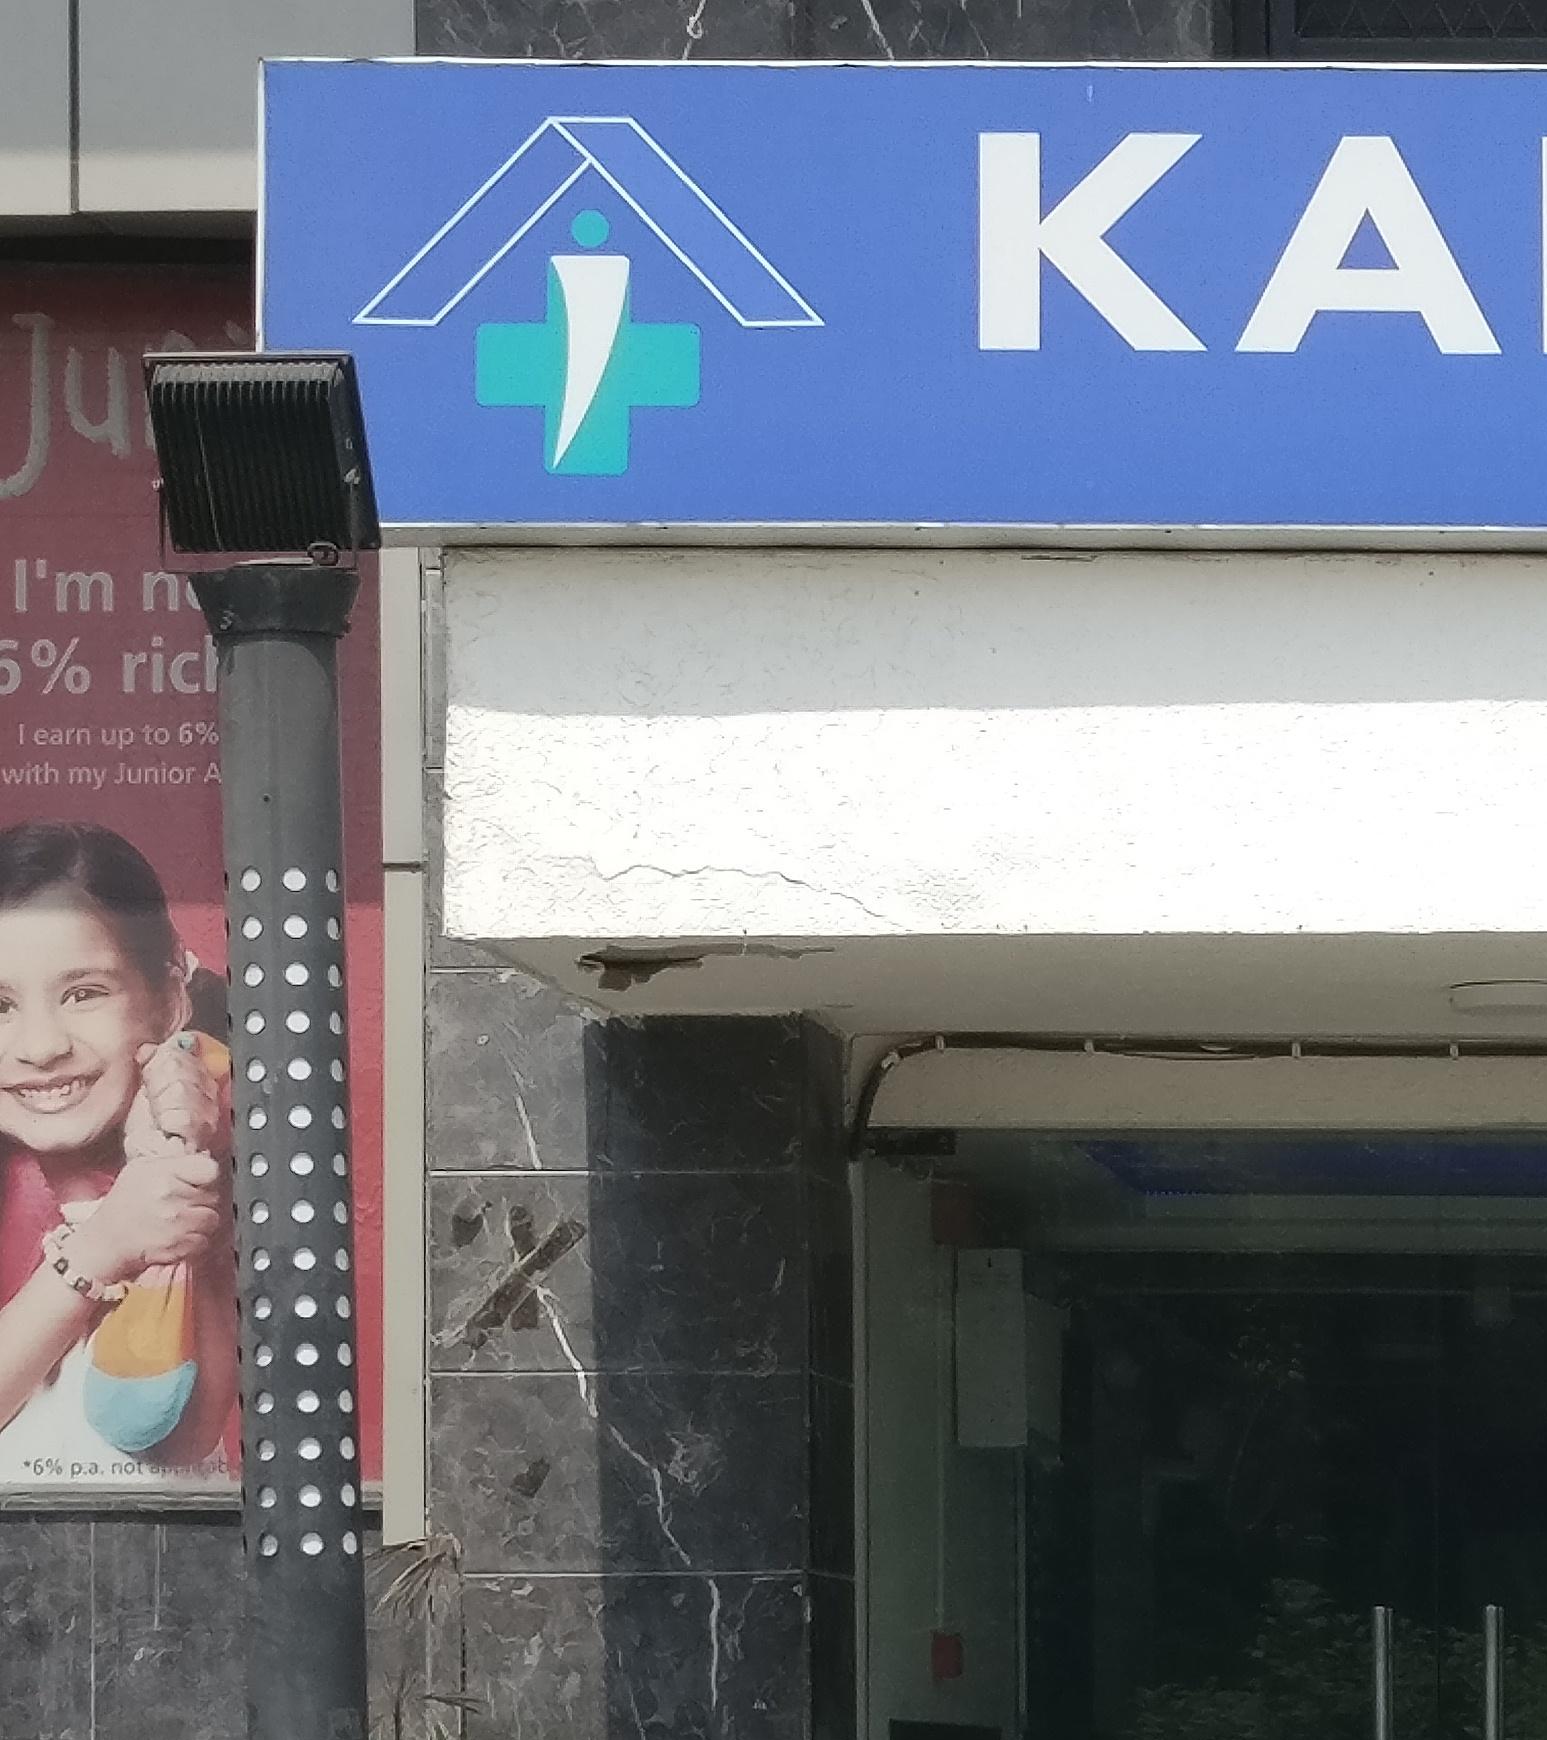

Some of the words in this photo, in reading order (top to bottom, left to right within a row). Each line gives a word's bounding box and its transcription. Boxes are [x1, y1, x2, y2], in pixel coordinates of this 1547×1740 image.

[15, 559, 114, 613] I'm
[142, 571, 202, 612] n
[33, 726, 91, 745] earn
[101, 727, 135, 750] up
[142, 724, 170, 745] to
[178, 721, 220, 746] 6%
[2, 762, 59, 784] with
[67, 766, 107, 790] my
[114, 762, 196, 785] Junior
[111, 1461, 143, 1475] not
